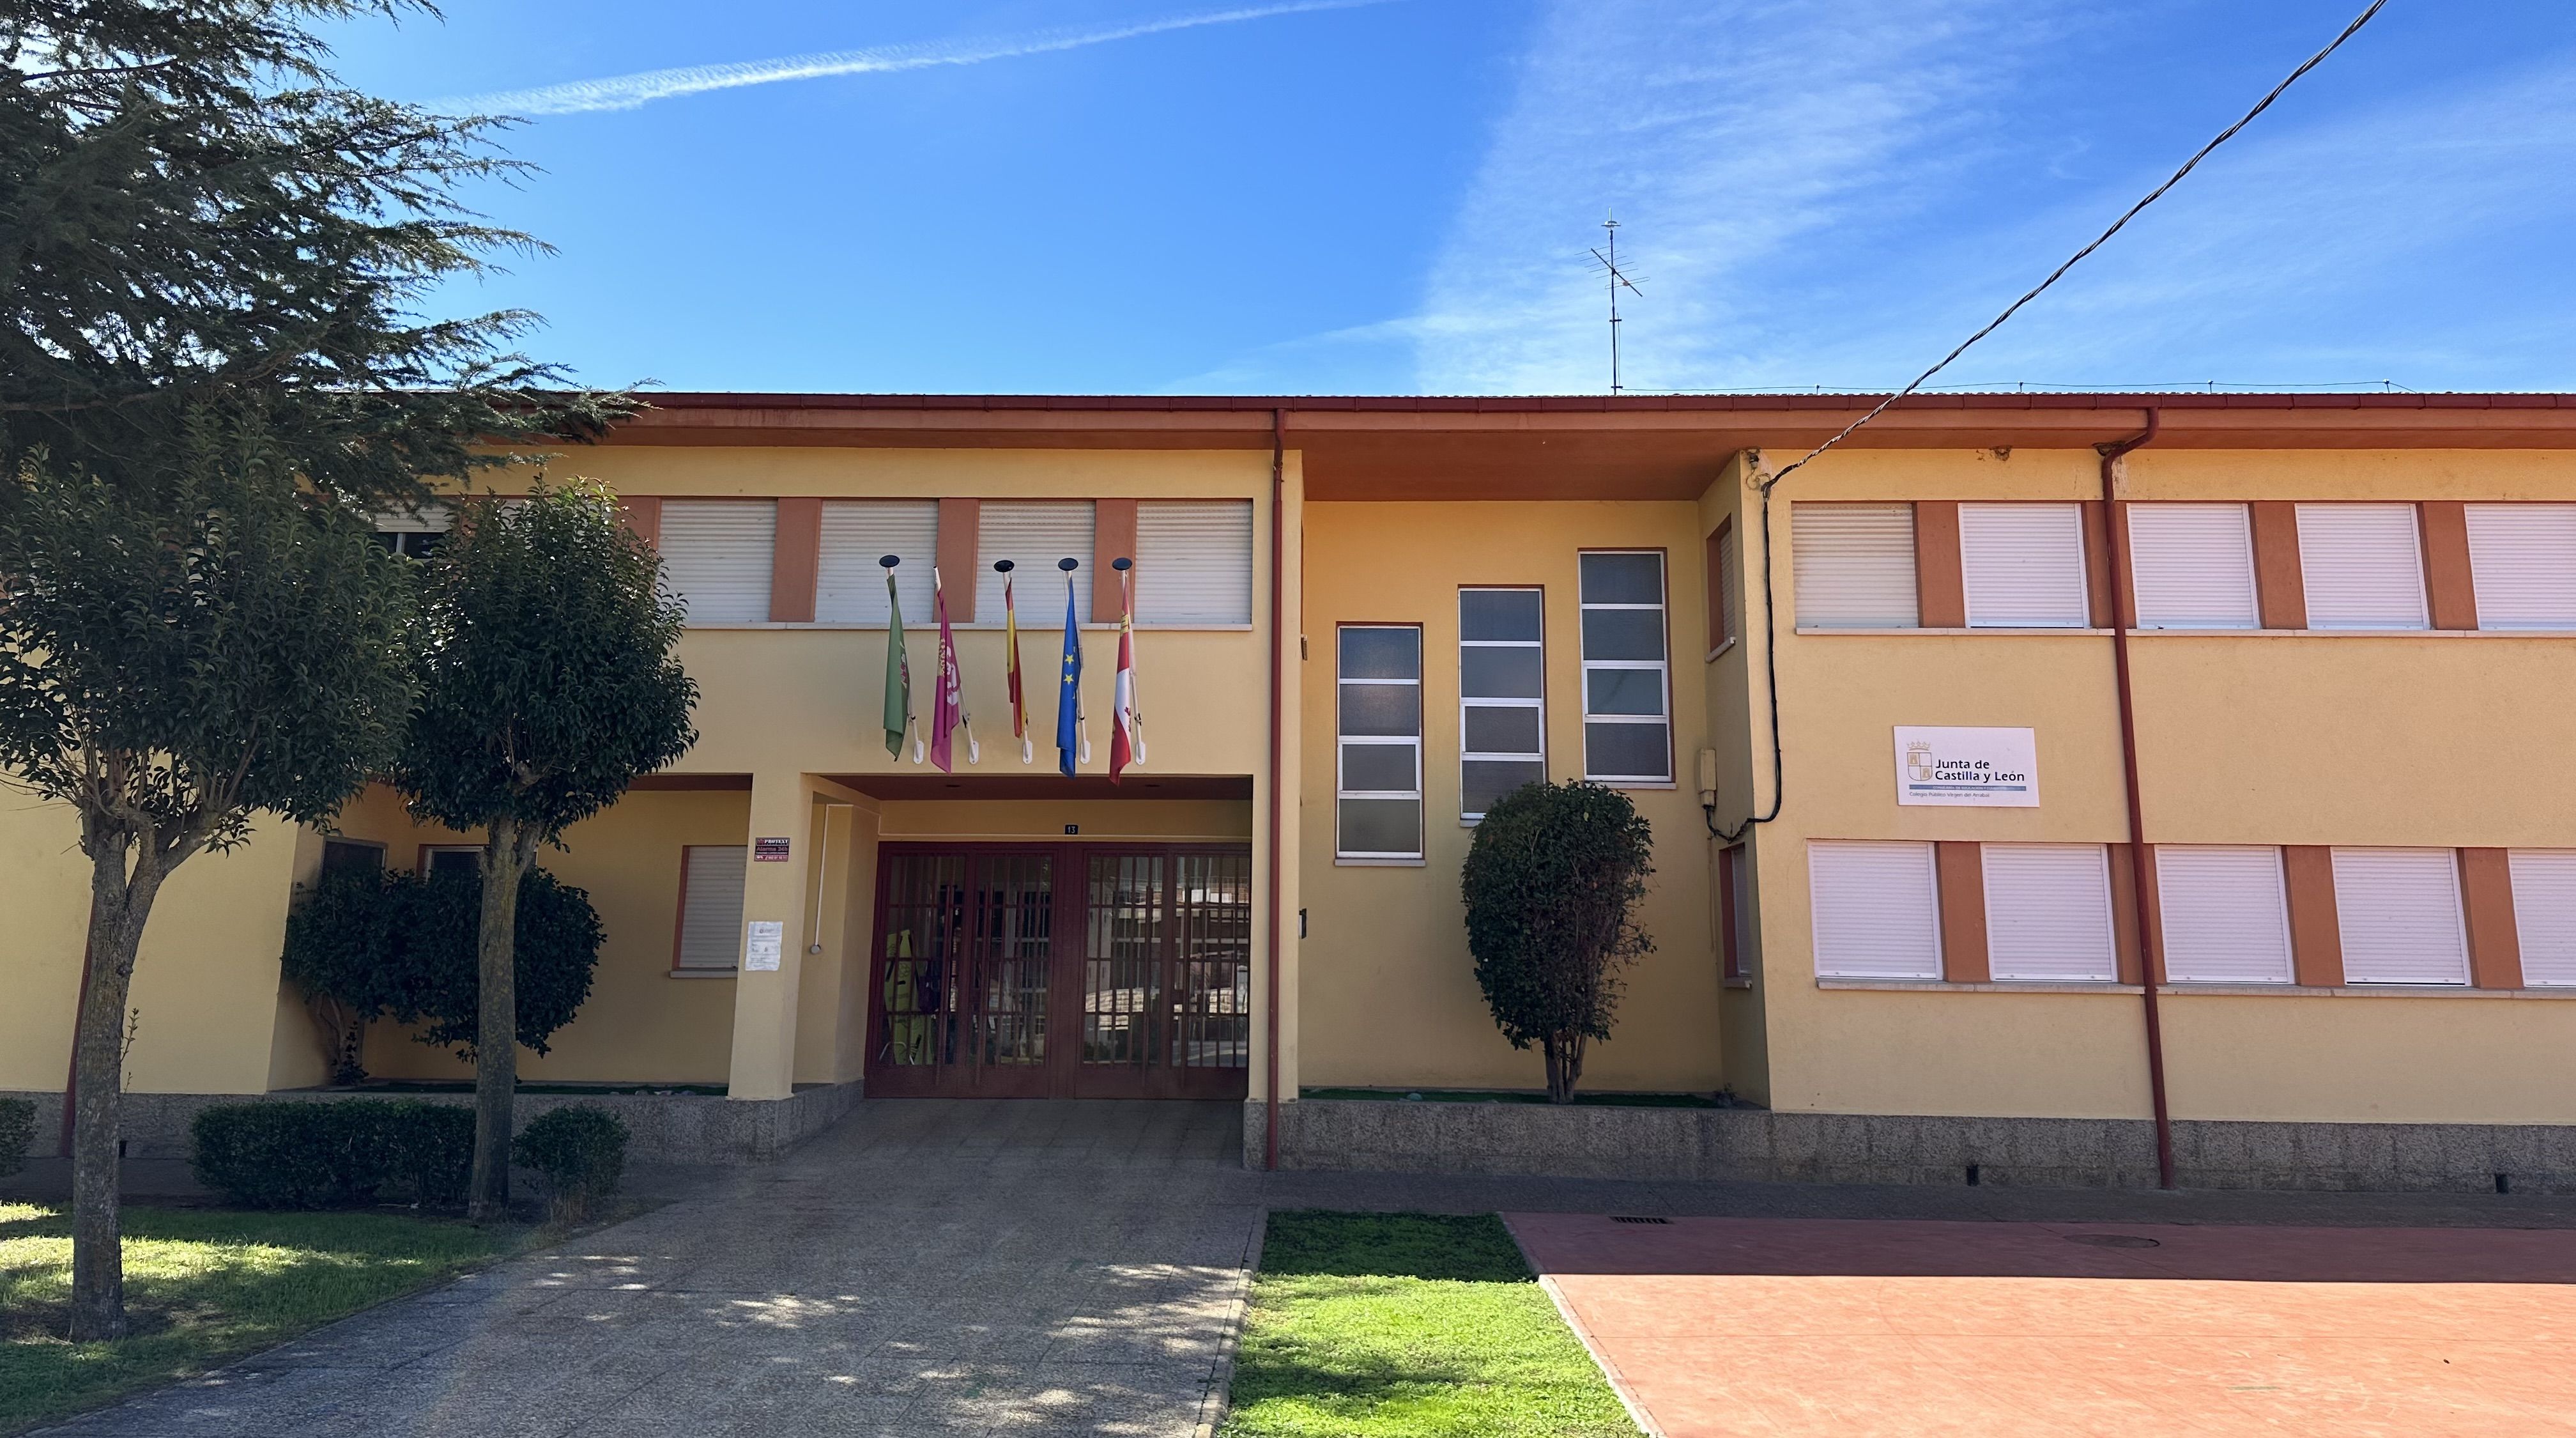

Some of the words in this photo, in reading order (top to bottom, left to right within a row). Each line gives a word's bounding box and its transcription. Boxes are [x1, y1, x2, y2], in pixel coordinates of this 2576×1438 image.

[1935, 759, 1970, 769] Junta
[1975, 759, 1990, 769] de
[1935, 771, 1980, 780] Castilla
[1982, 773, 1991, 784] y
[1995, 771, 2025, 782] León
